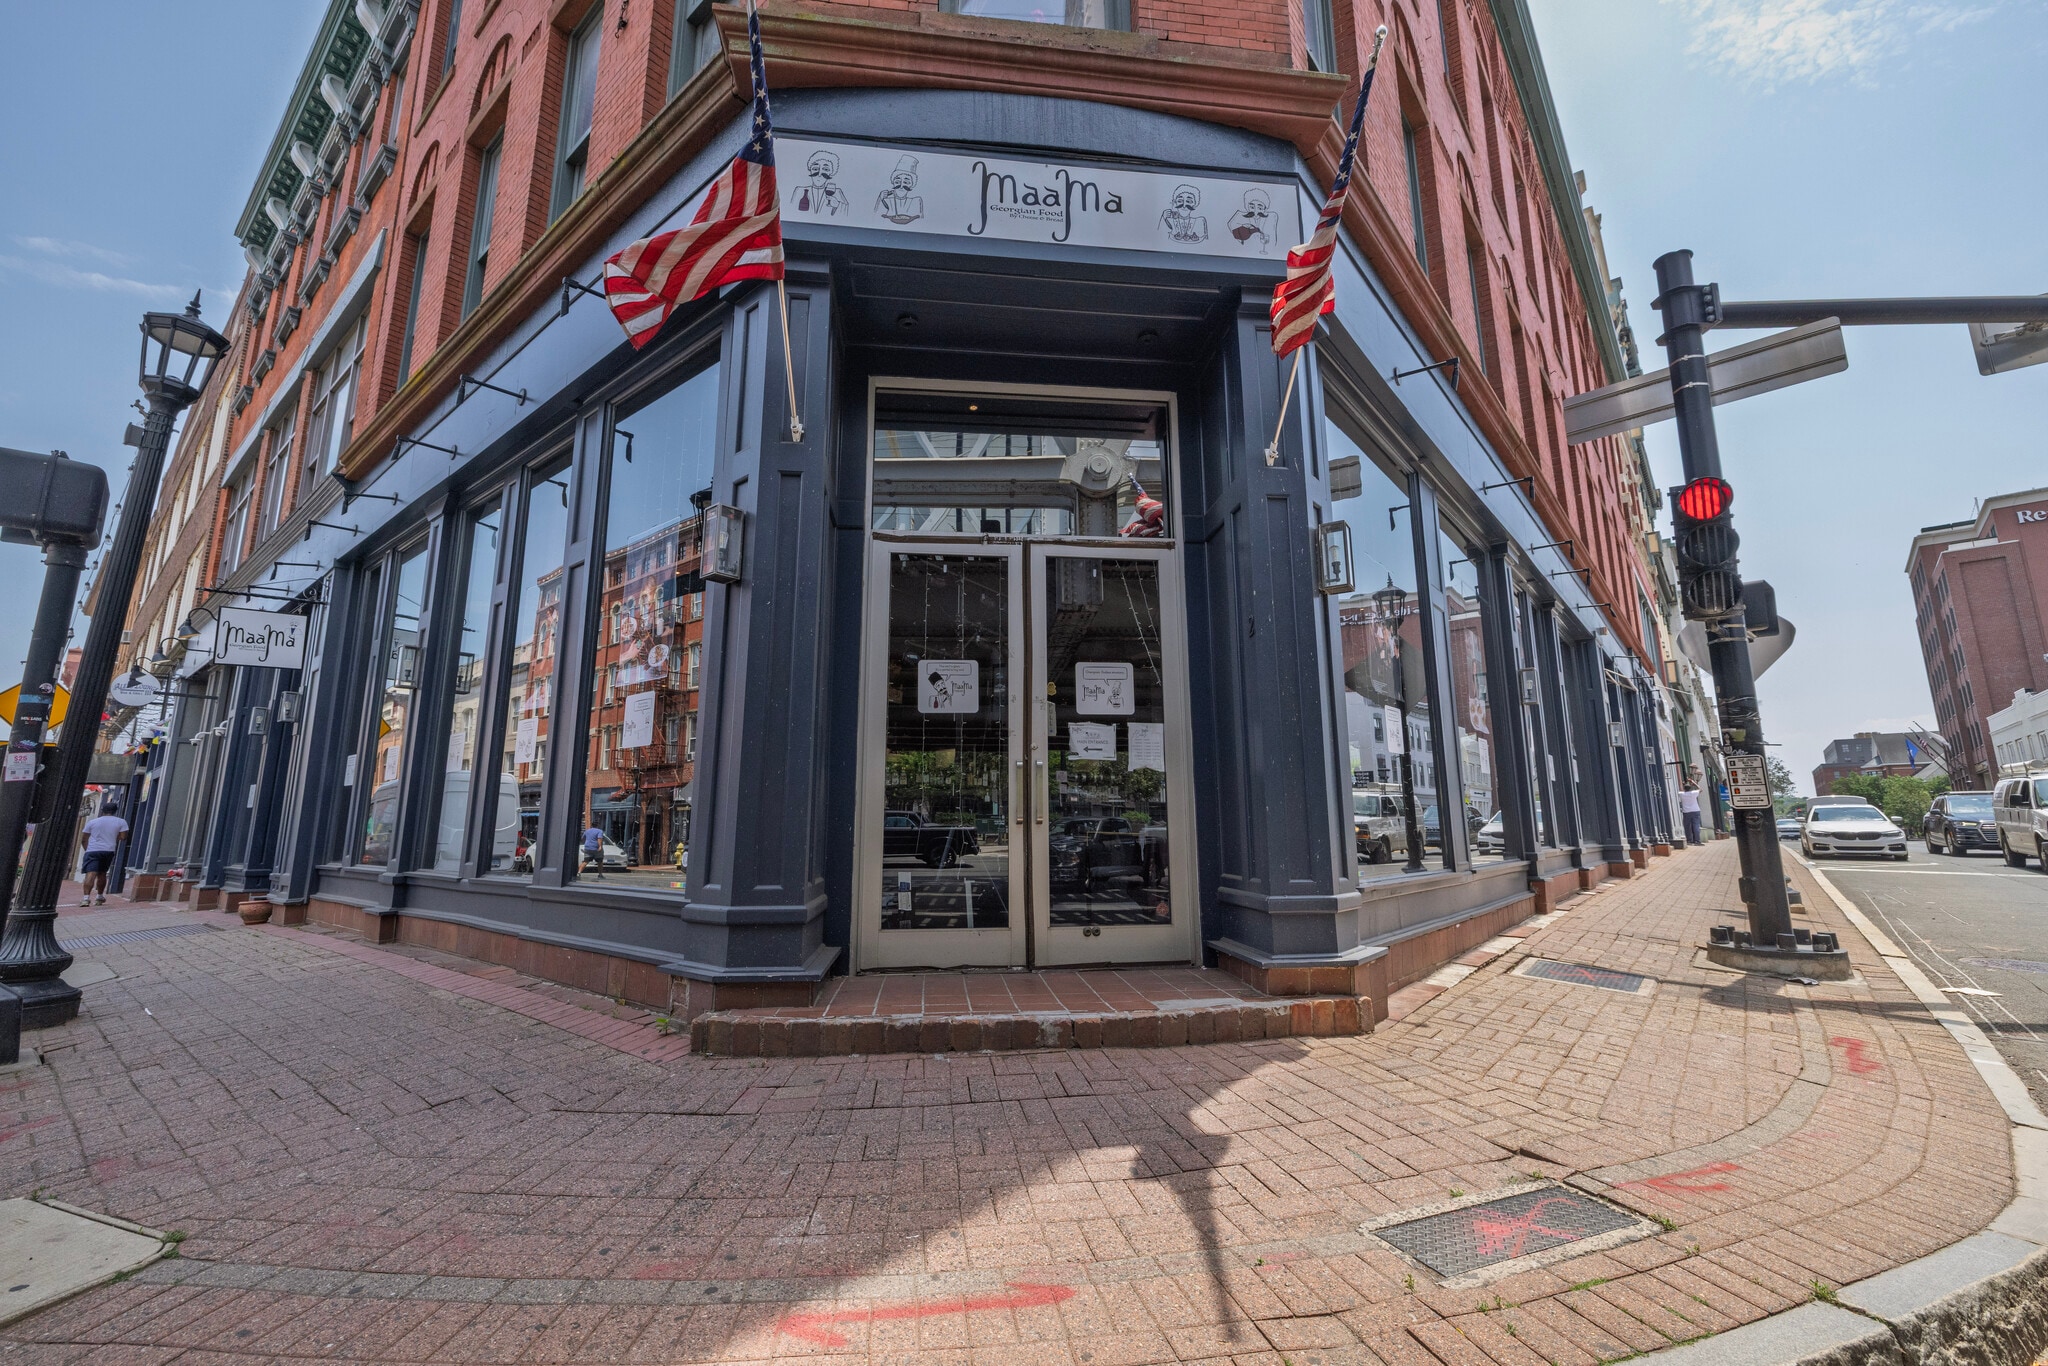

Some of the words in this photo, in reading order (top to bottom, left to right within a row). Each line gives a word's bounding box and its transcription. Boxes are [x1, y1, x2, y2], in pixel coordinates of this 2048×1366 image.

[990, 204, 1036, 215] Georgian
[1039, 208, 1064, 217] Food
[2016, 510, 2048, 524] Re
